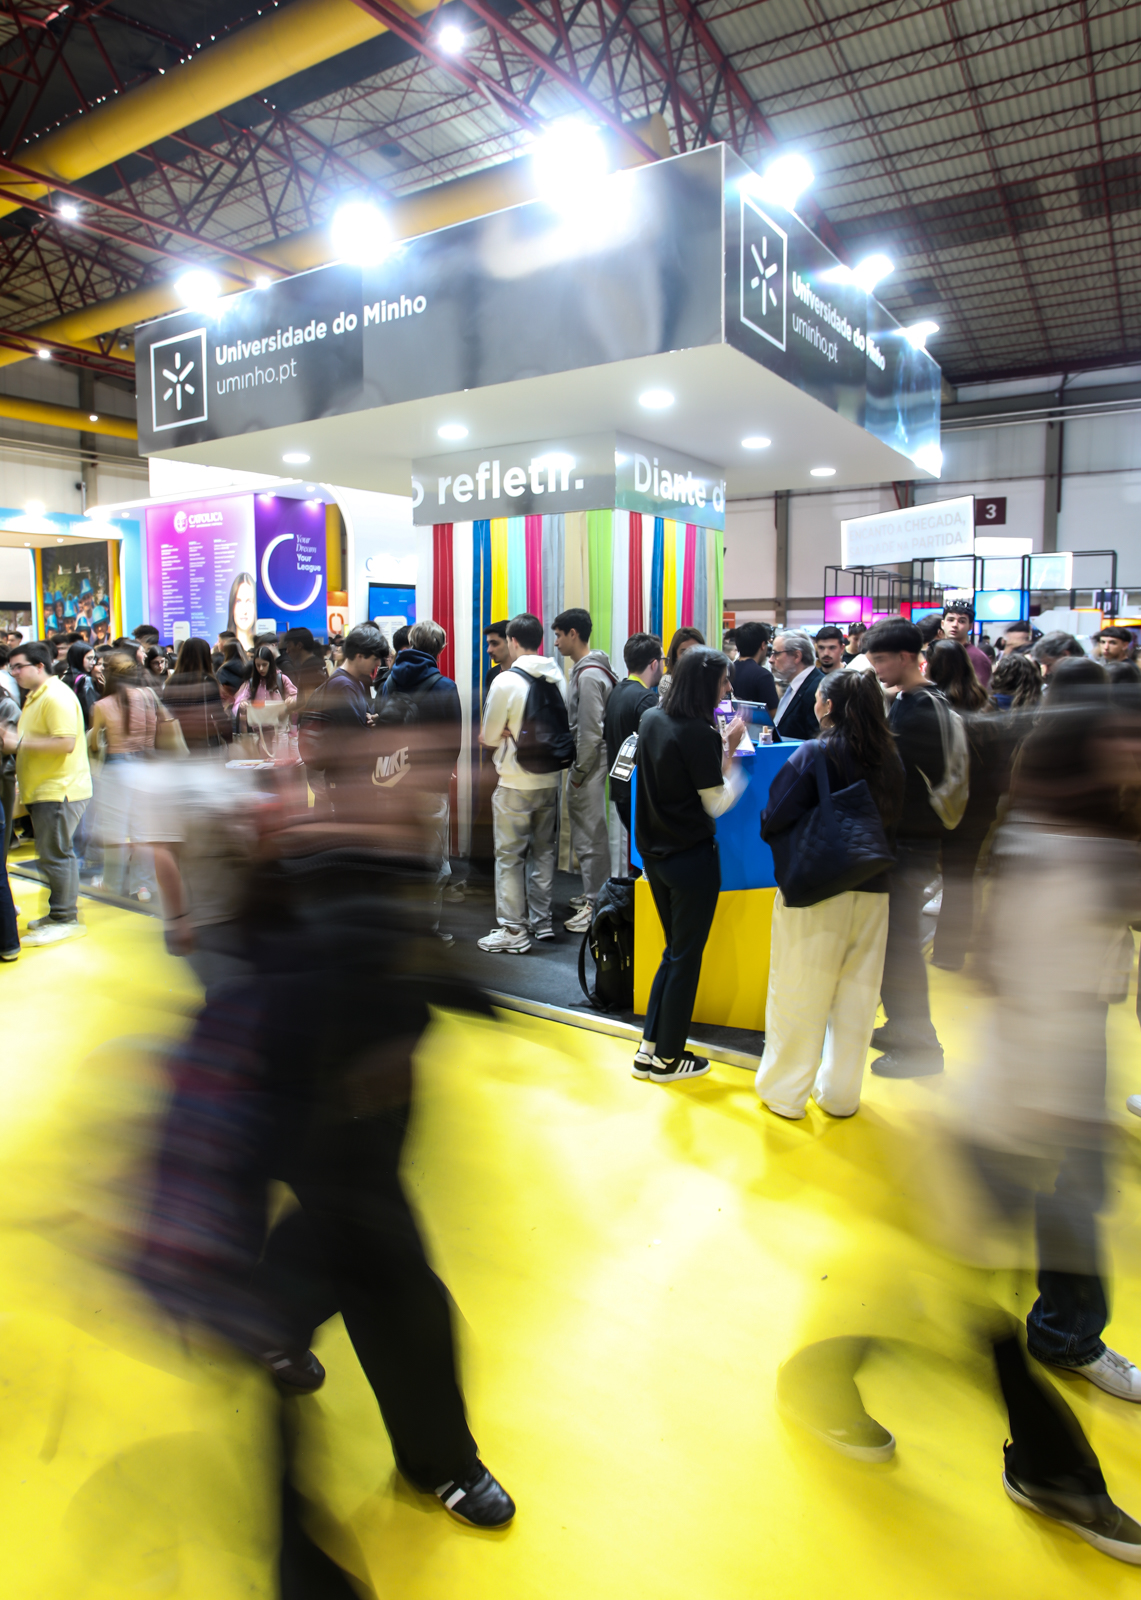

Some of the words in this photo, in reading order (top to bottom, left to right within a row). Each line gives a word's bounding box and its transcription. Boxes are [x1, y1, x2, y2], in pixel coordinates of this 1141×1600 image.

[792, 271, 852, 342] Universidade
[853, 327, 866, 352] do
[215, 320, 328, 366] Universidade
[331, 311, 358, 335] do
[363, 294, 428, 327] Minho
[792, 313, 838, 363] uminho.pt
[216, 358, 298, 395] uminho.pt
[438, 456, 585, 506] refletir.
[633, 452, 707, 509] Diante
[849, 523, 895, 543] ENCANTO
[904, 511, 966, 533] CHEGADA,
[985, 504, 997, 519] 3
[296, 534, 311, 544] Your
[296, 553, 312, 563] Your
[297, 562, 322, 573] League
[375, 746, 409, 778] NIKE
